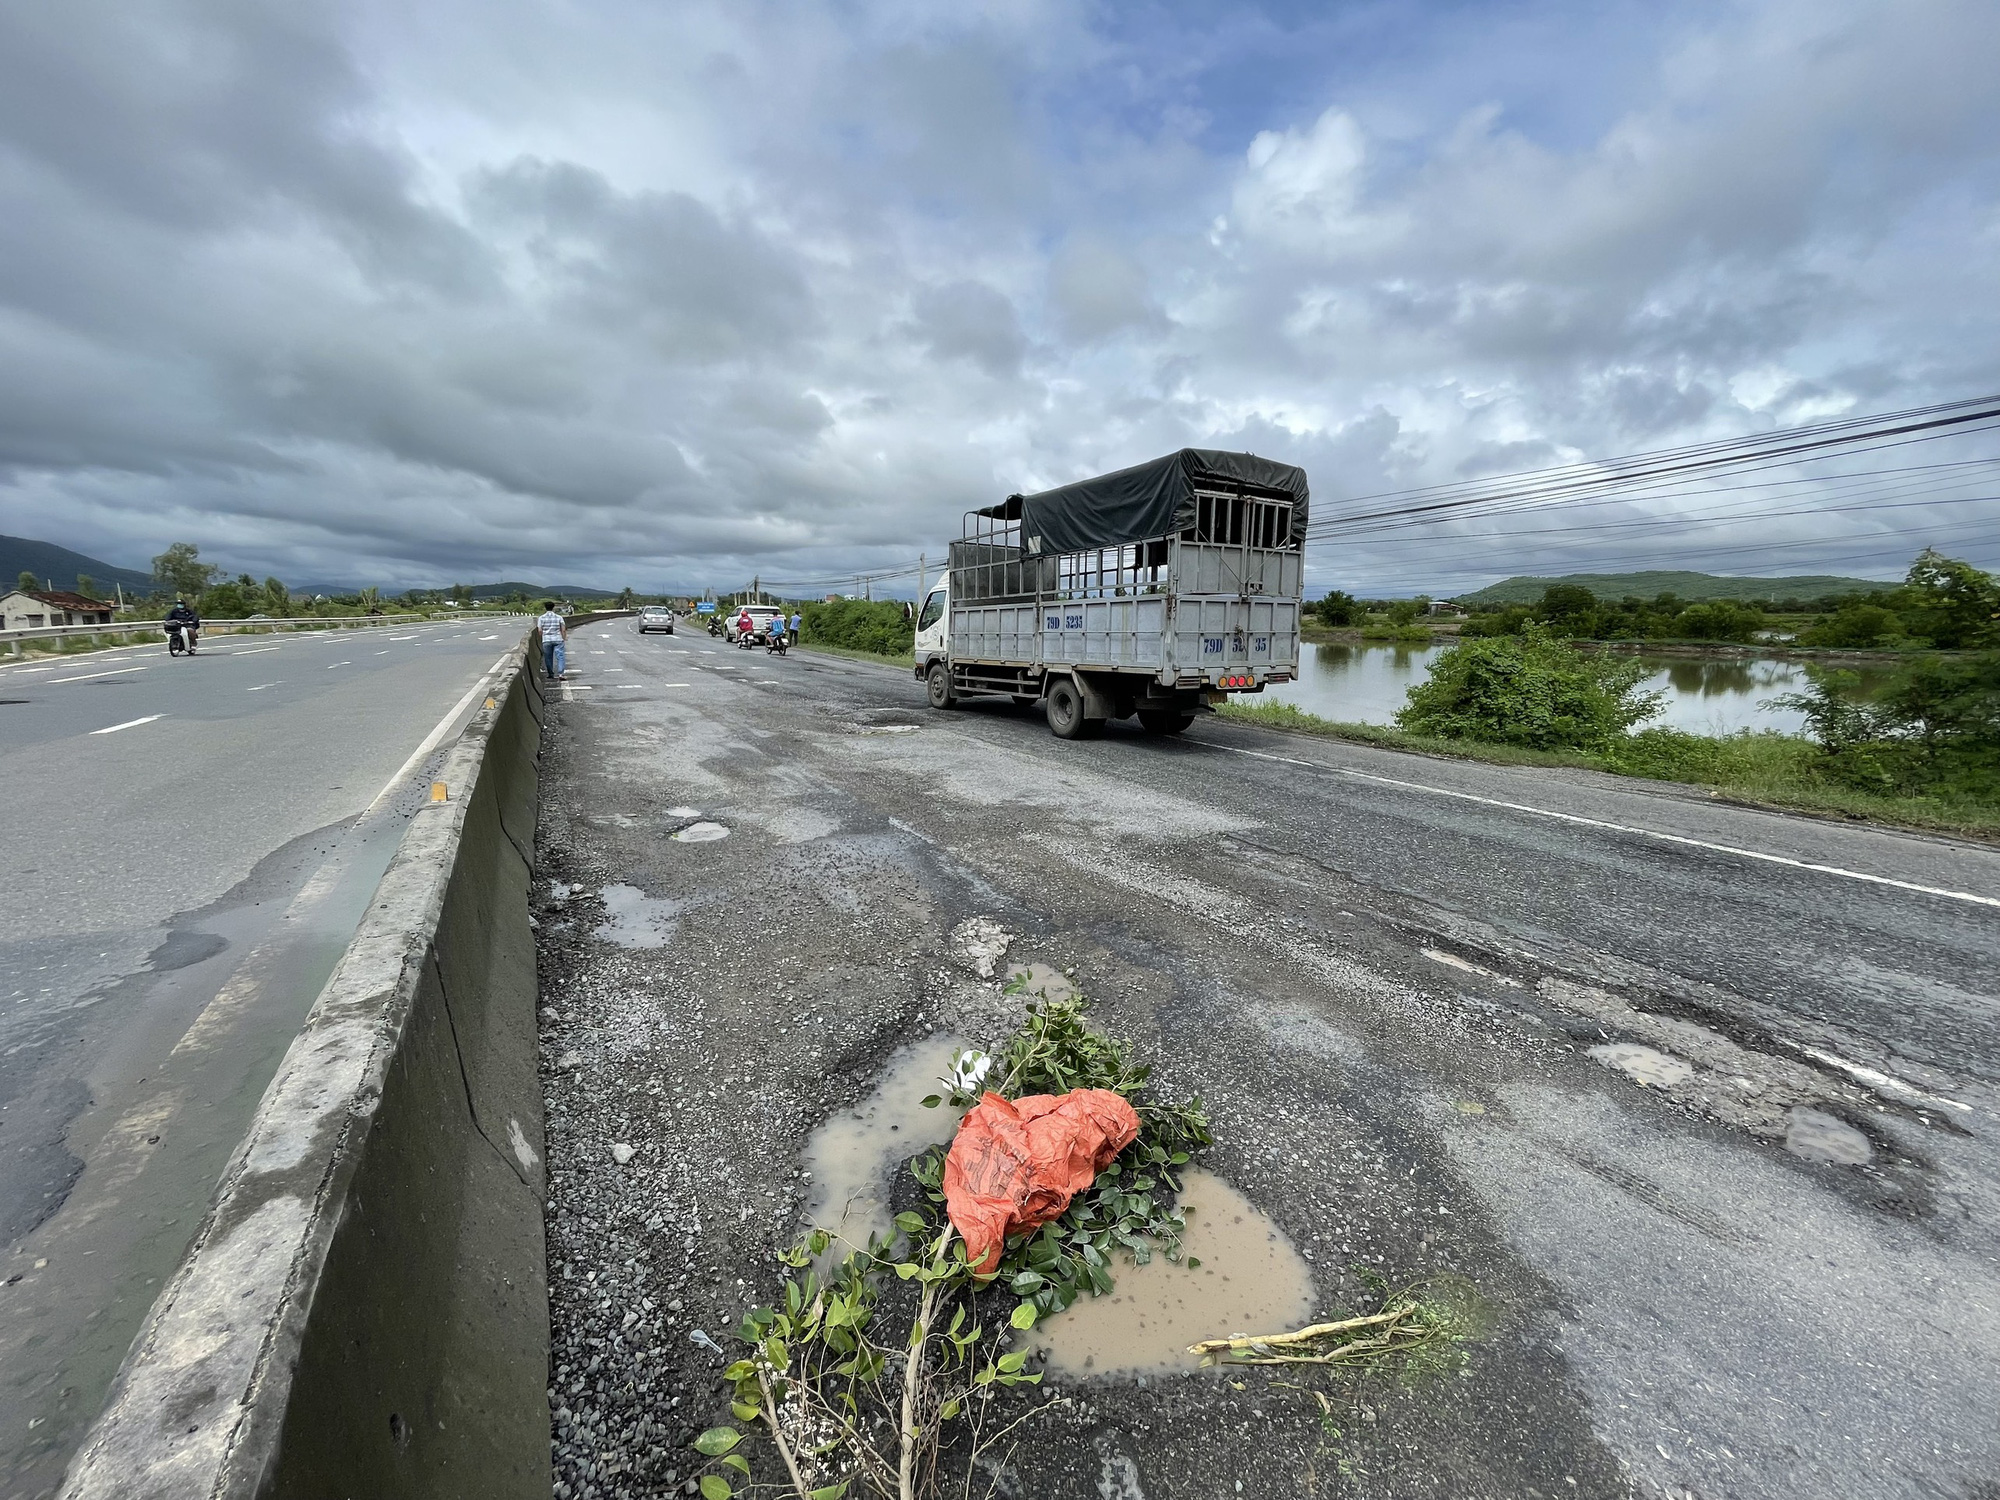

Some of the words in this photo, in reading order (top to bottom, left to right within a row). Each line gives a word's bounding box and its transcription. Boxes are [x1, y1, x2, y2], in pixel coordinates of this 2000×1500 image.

[1046, 616, 1060, 630] 79D
[1065, 615, 1083, 629] 5235
[1203, 638, 1223, 654] 79D
[1255, 637, 1267, 652] 35
